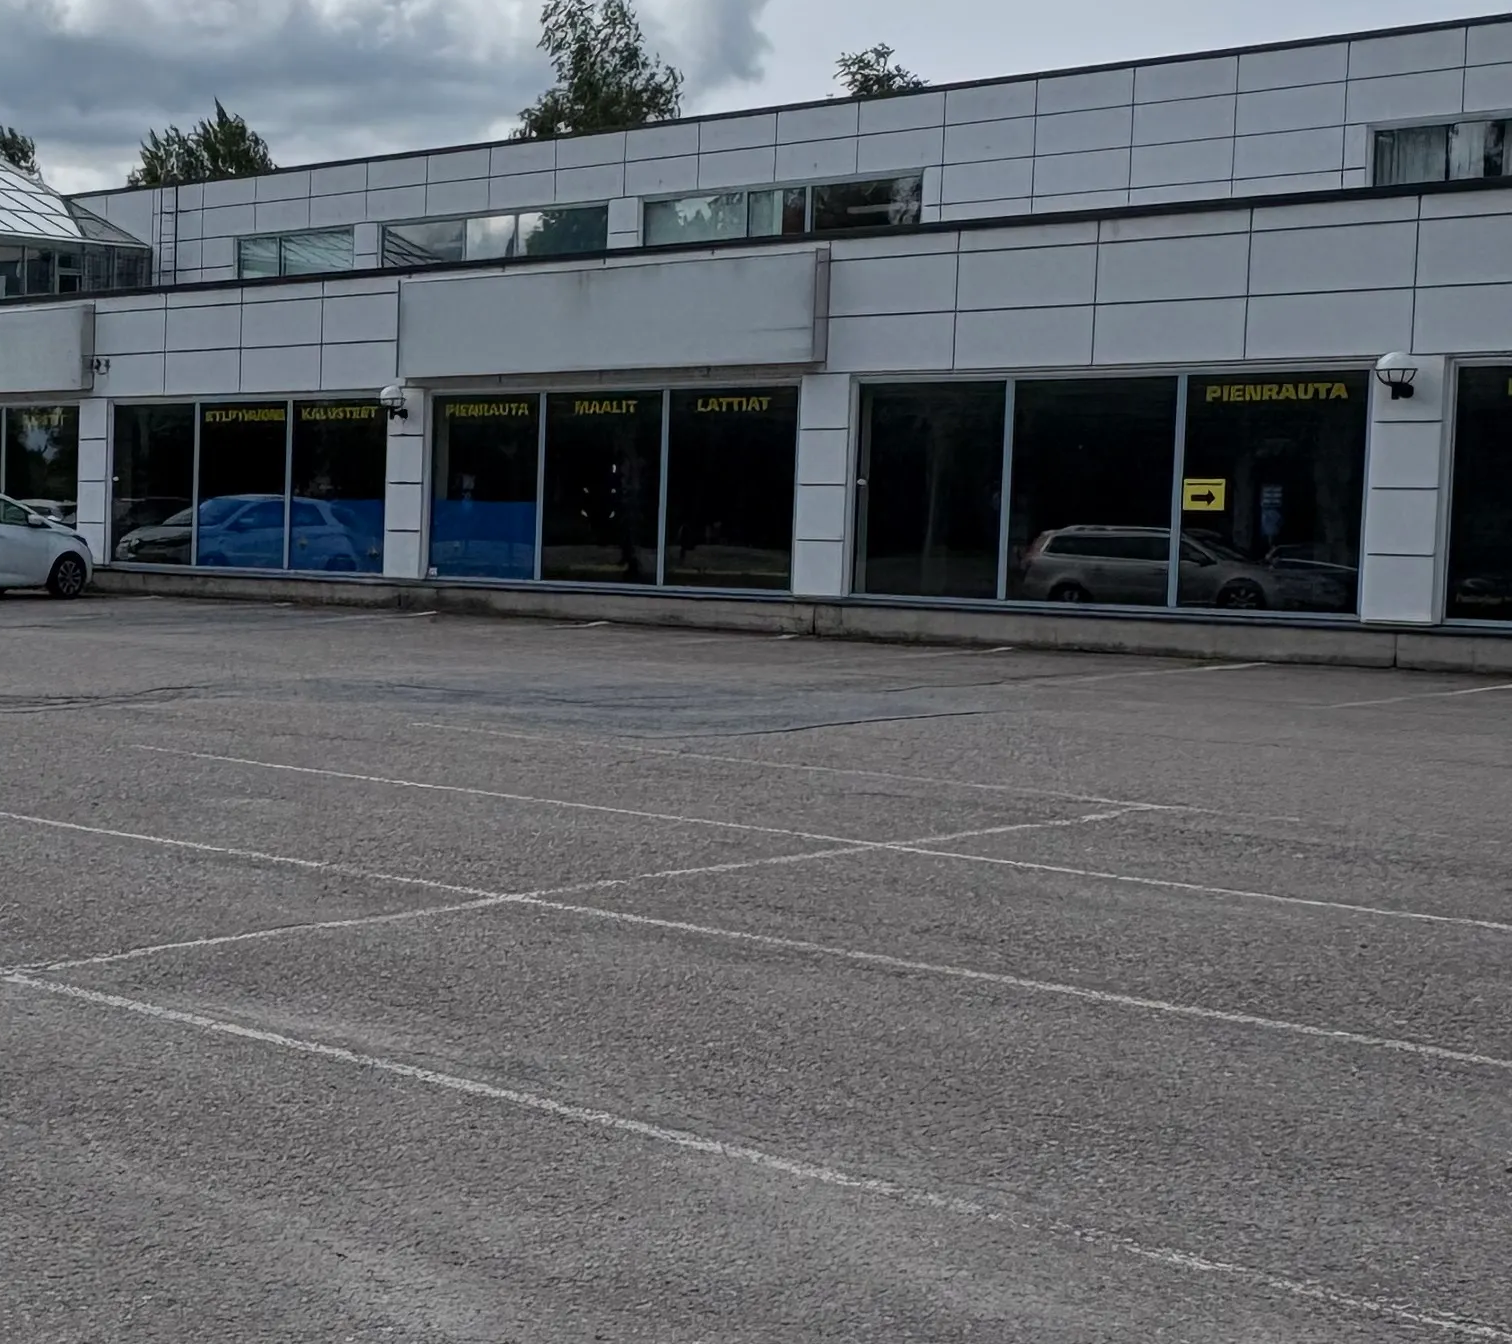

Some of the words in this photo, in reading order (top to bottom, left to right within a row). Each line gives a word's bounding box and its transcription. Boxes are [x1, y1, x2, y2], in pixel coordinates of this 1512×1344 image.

[1205, 382, 1349, 403] PIENRAUTA
[573, 399, 638, 415] MAALIT
[697, 396, 772, 412] LATTIAT
